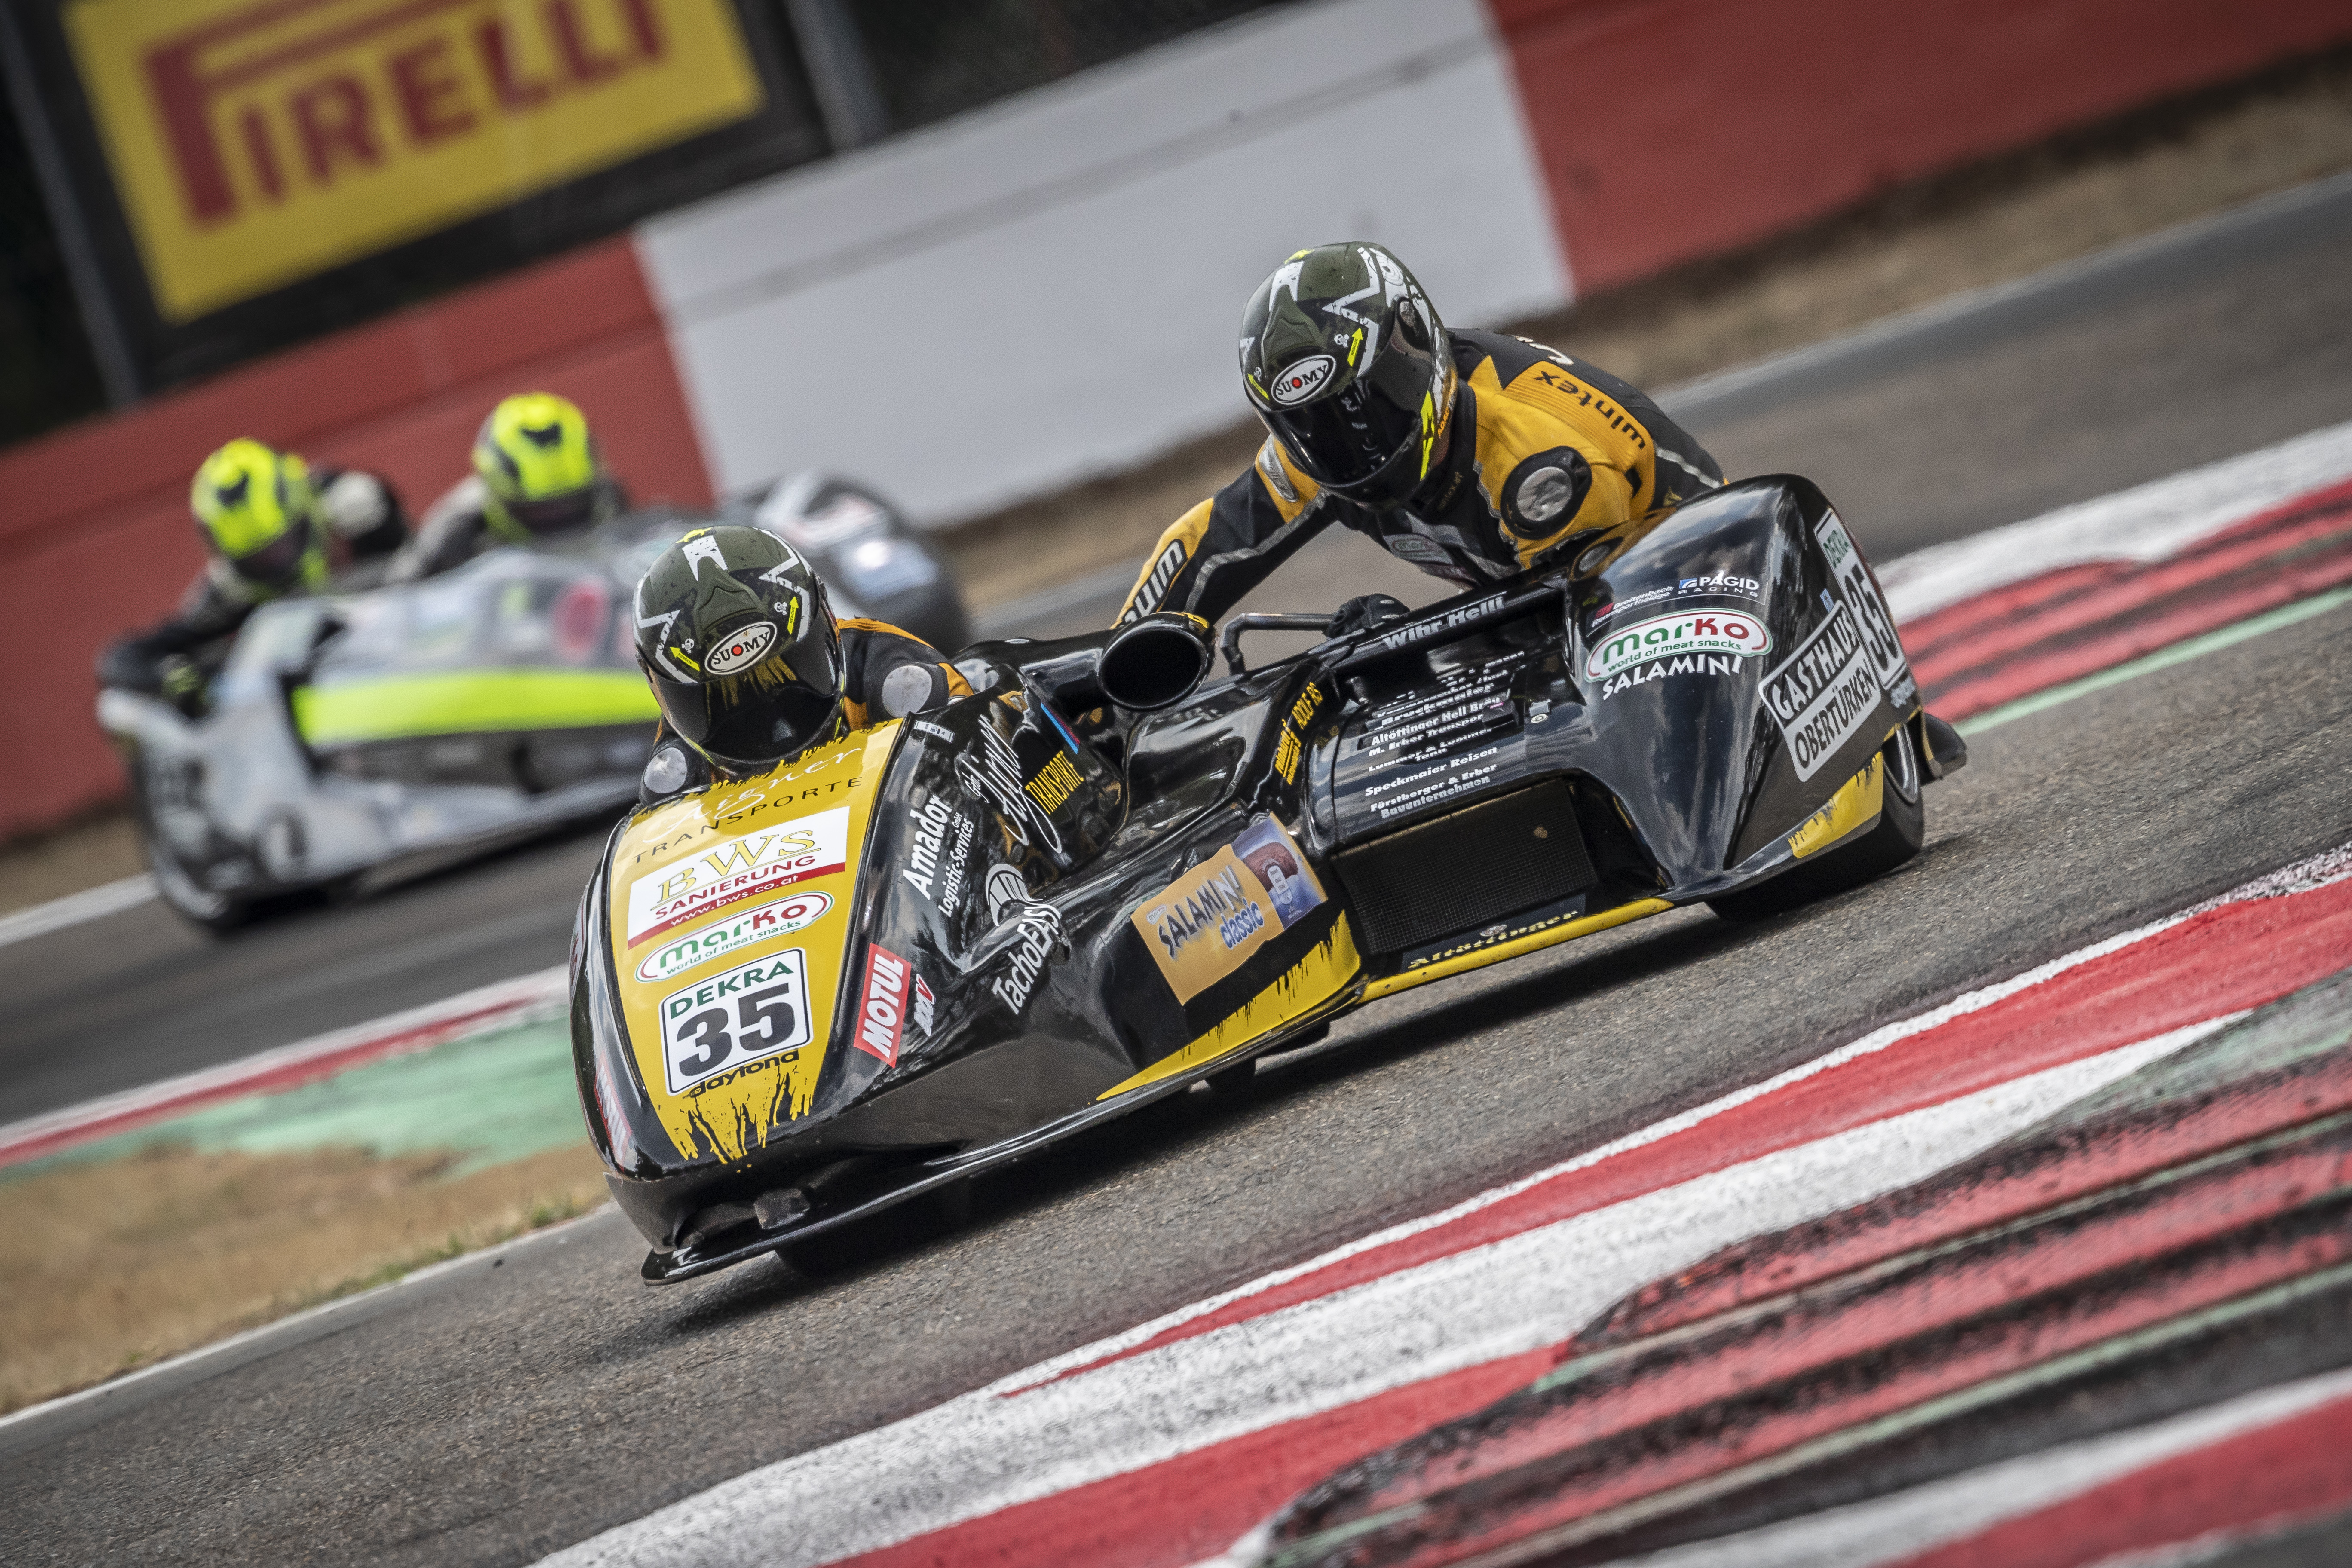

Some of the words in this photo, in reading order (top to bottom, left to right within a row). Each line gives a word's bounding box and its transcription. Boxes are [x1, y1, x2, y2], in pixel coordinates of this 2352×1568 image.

[140, 0, 671, 234] PIRELLI
[1276, 364, 1328, 395] SUOMY
[1534, 370, 1646, 450] wintex
[1678, 586, 1758, 597] RACING
[1699, 576, 1760, 590] PAGID
[711, 631, 769, 665] SUOMY
[1607, 652, 1642, 672] world
[1645, 647, 1658, 657] of
[1661, 640, 1694, 653] meat
[1697, 639, 1741, 651] snacks
[1773, 609, 1857, 720] GASTHAUS
[1602, 653, 1743, 701] SALAMINI
[1794, 658, 1877, 769] OBERTÜRKEN
[1365, 763, 1448, 796] Speckmaier
[1449, 747, 1498, 768] Reisen
[1368, 747, 1386, 757] M.
[1389, 733, 1425, 751] Erber
[1025, 750, 1084, 815] TRANSPORTE
[1370, 781, 1446, 812] Fürstberger
[1447, 776, 1459, 786] &
[1461, 764, 1498, 781] Erber
[1380, 775, 1491, 819] Bauunternehmen
[633, 776, 863, 864] TRANSPORTE
[903, 794, 952, 901] Amador
[952, 812, 963, 828] GmbH
[655, 855, 816, 920] SANIERUNG
[657, 830, 814, 904] BWS
[938, 818, 974, 918] Logistic-Services
[670, 874, 799, 926] www.bws.co.at
[1158, 864, 1243, 960] SALAMINI
[1219, 896, 1265, 950] classic
[666, 954, 701, 974] world
[705, 946, 718, 958] of
[721, 934, 754, 951] meat
[757, 920, 801, 938] snacks
[991, 903, 1062, 1016] TachoEASY
[670, 960, 794, 1020] DEKRA
[861, 952, 904, 1059] MOTUL
[677, 982, 796, 1077] 35
[689, 1050, 800, 1098] daytona
